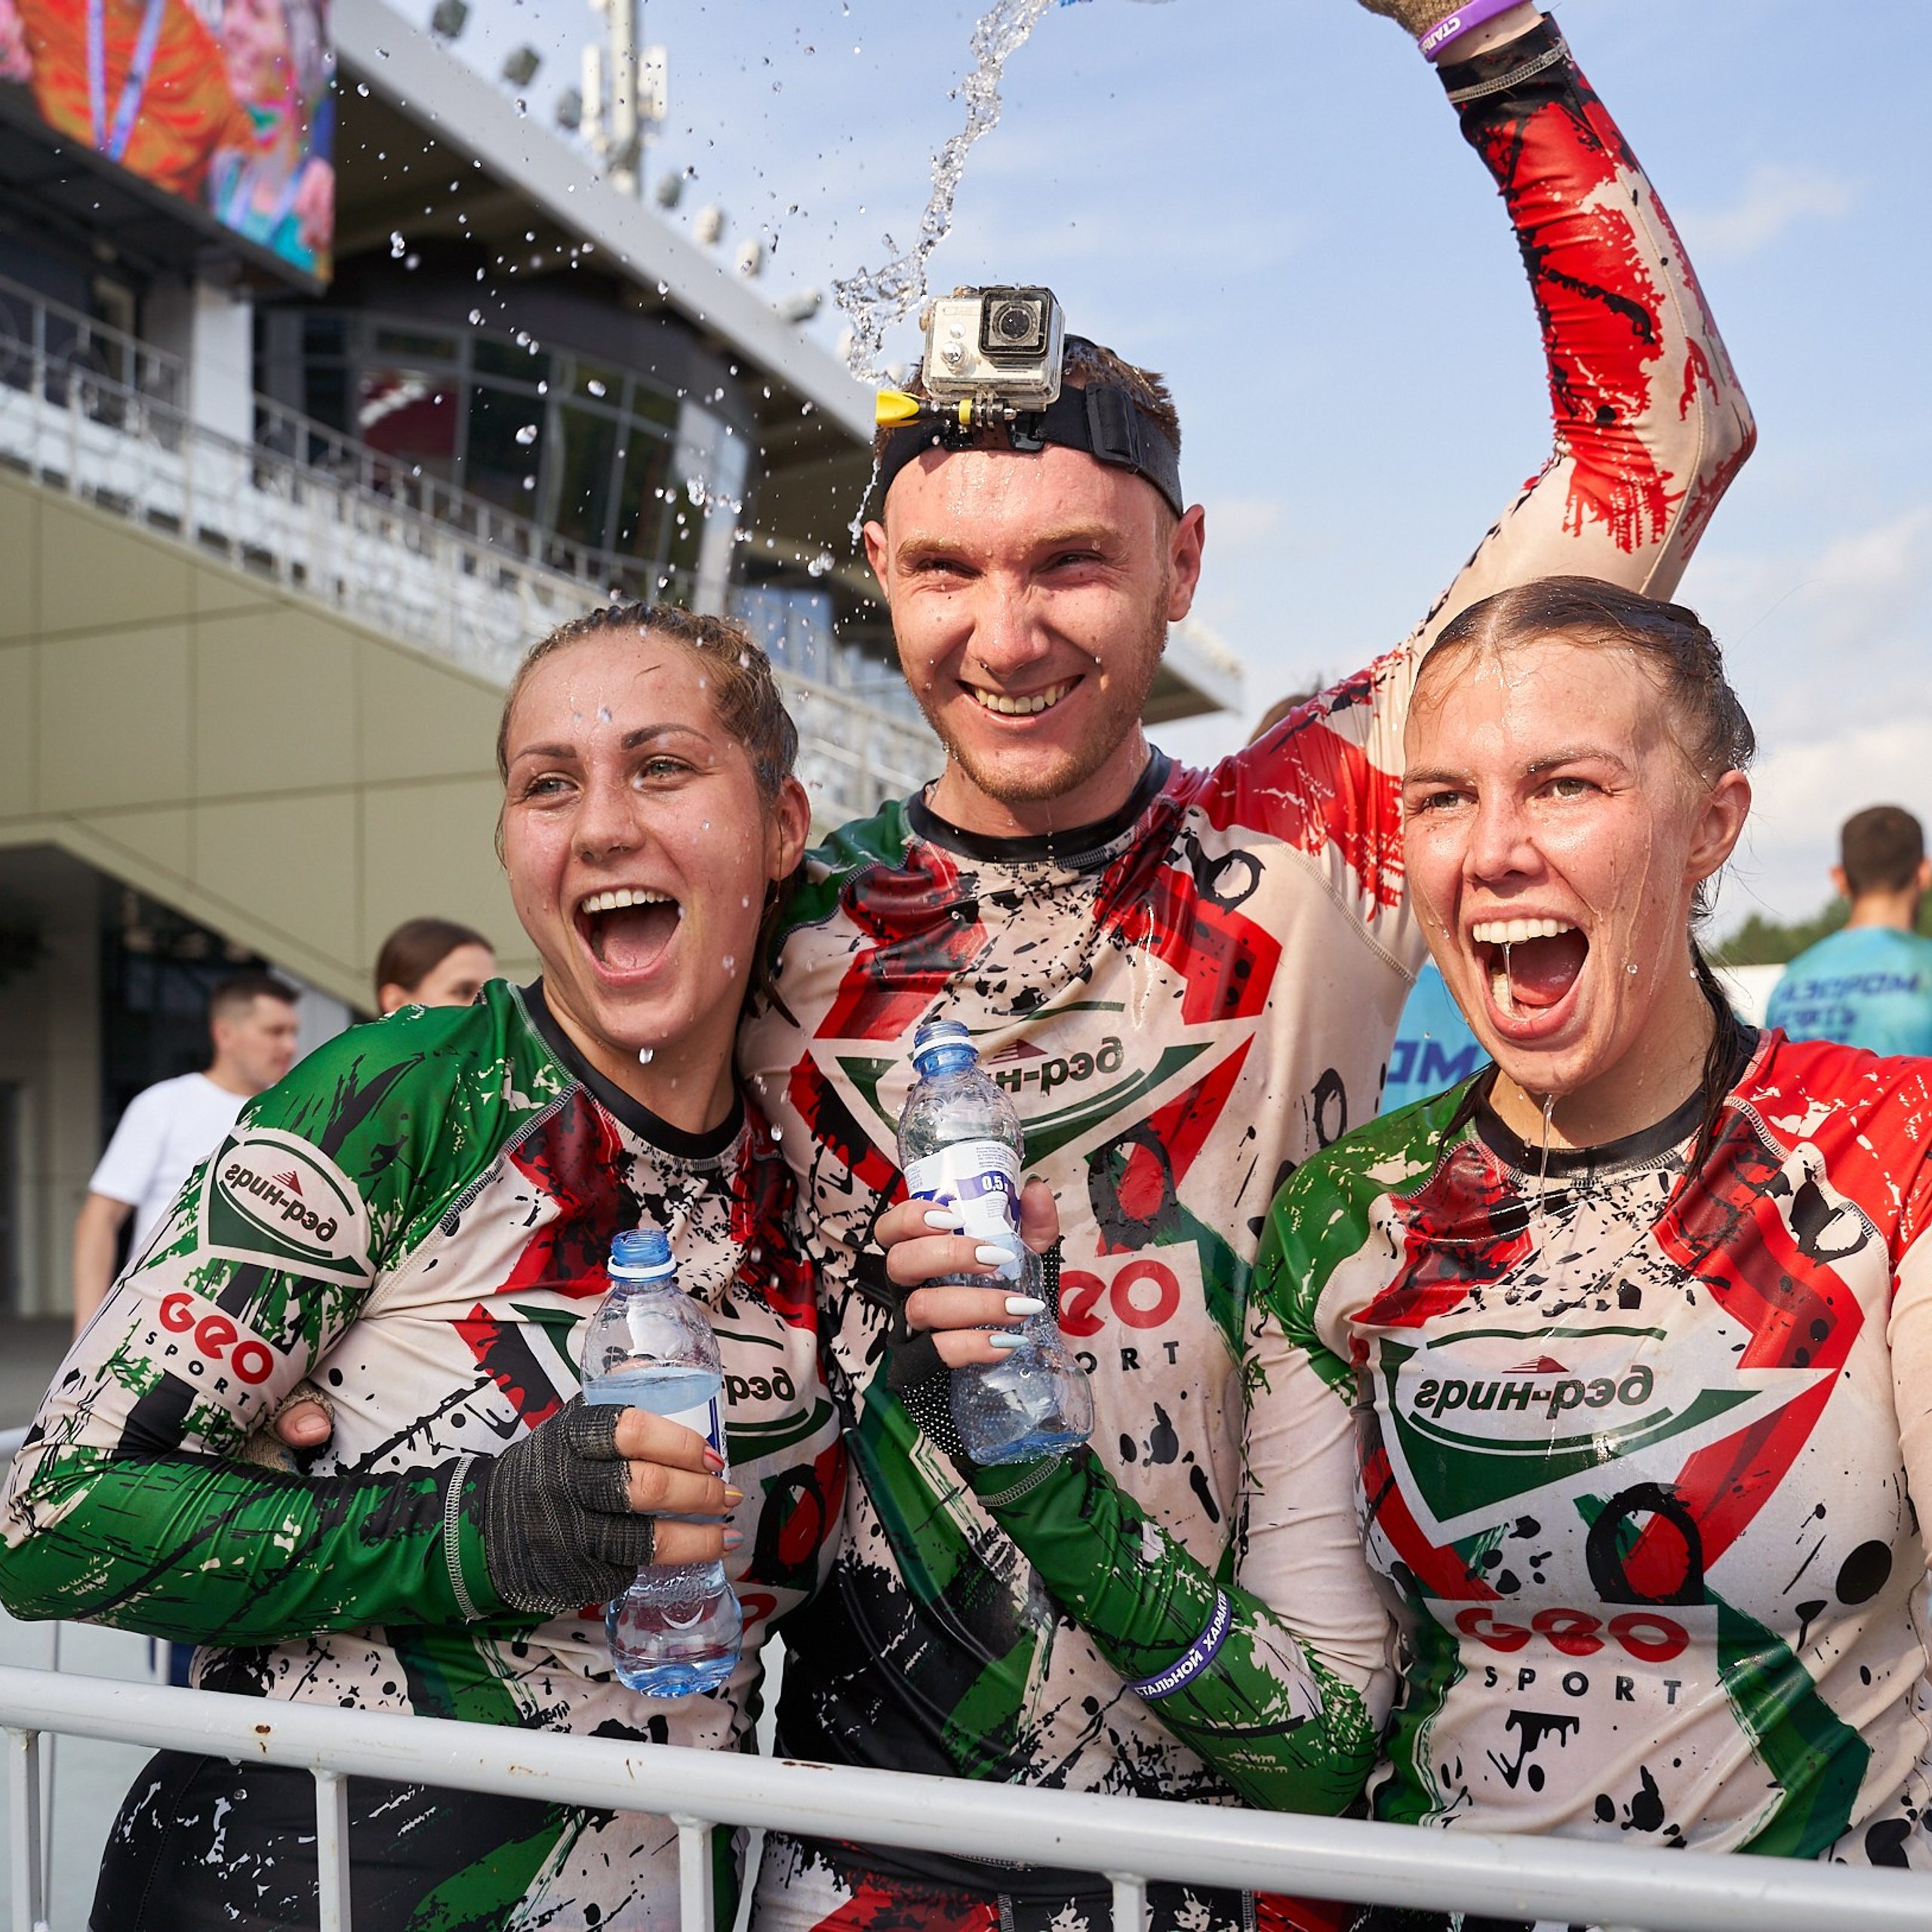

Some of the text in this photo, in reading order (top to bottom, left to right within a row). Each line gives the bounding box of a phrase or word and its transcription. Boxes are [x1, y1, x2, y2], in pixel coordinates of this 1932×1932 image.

[982, 1175, 1004, 1192] 0,5
[145, 1331, 251, 1407] SPORT
[1075, 1341, 1180, 1375] ORT
[1134, 1648, 1204, 1696] СТАЛЬНОЙ
[1484, 1666, 1681, 1705] SPORT
